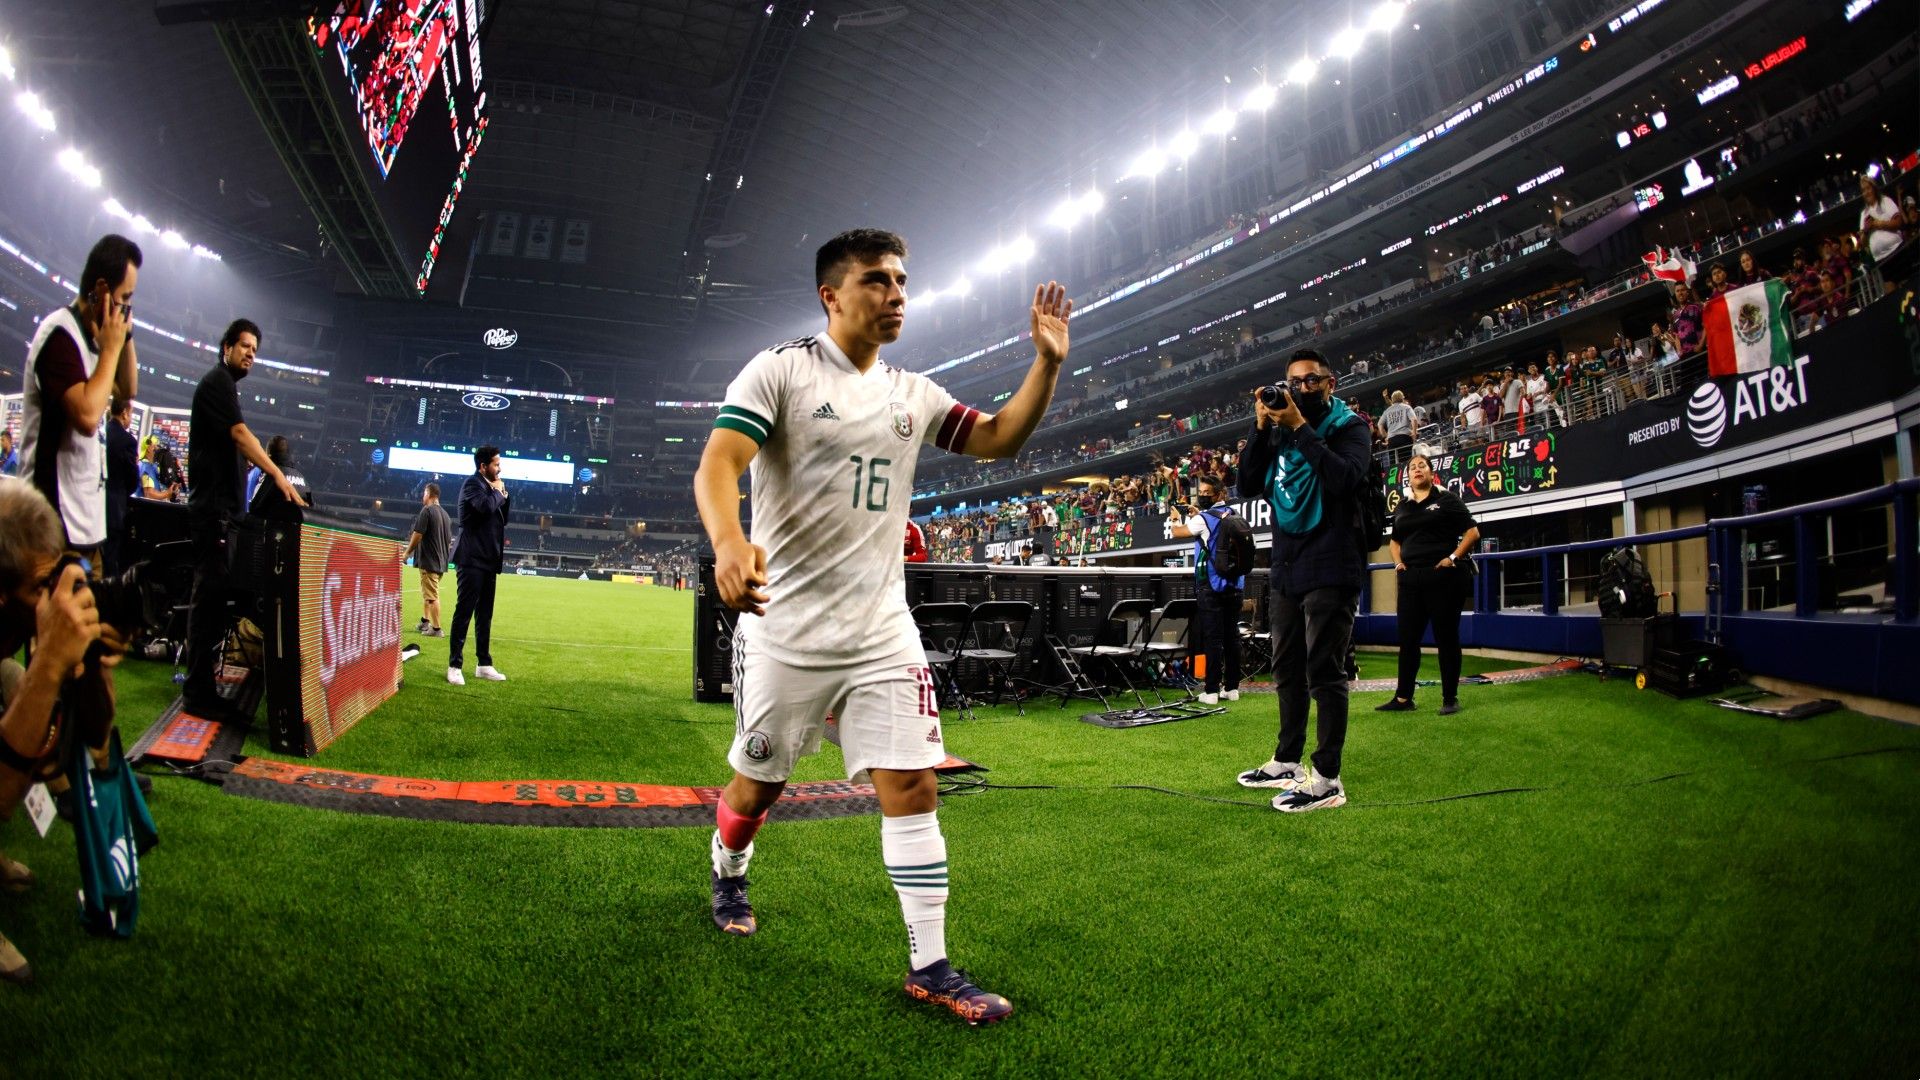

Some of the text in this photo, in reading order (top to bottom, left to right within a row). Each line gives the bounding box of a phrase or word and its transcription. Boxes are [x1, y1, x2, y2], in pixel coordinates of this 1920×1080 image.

[1744, 63, 1763, 79] VS.
[1761, 36, 1807, 71] URUGUAY
[1487, 83, 1515, 105] POWERED
[1515, 78, 1524, 89] BY
[1545, 57, 1558, 72] 5G
[1520, 128, 1532, 138] LEE
[1546, 108, 1570, 126] JORDAN
[1633, 124, 1652, 138] VS.
[1517, 165, 1565, 194] NEXT MATCH
[1253, 291, 1287, 310] NEXT MATCH
[487, 329, 515, 346] Pepper
[471, 394, 501, 408] Ford
[1628, 355, 1810, 445] PRESENTED BY AT&T
[812, 412, 841, 420] adidas
[850, 455, 891, 512] 16
[320, 572, 400, 686] Sabritas
